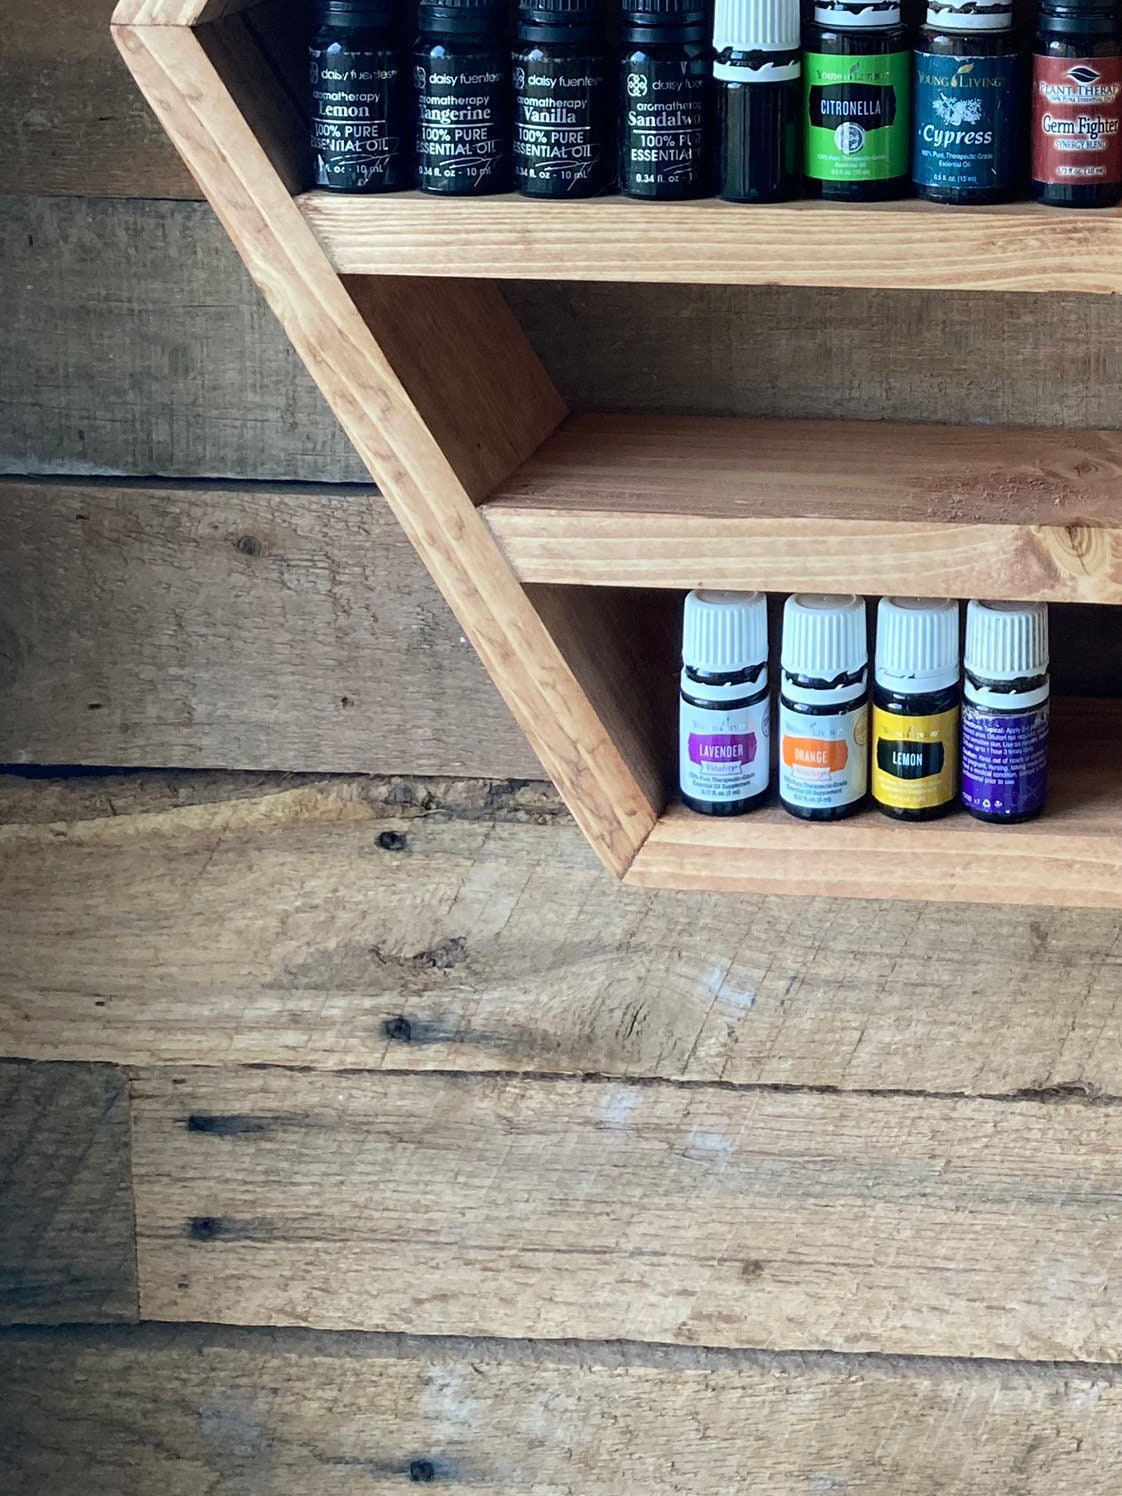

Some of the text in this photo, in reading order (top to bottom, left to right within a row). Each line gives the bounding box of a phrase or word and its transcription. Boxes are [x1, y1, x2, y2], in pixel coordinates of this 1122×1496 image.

[429, 73, 500, 86] daisy fuentes
[528, 75, 556, 88] daisy
[918, 71, 1001, 87] YOUNG LIVING
[1040, 82, 1072, 96] PLANT
[419, 95, 489, 106] aromatherapy
[517, 96, 587, 109] aromatherapy
[320, 102, 370, 117] Lemon
[420, 104, 491, 124] Tangerine
[523, 106, 576, 123] Vanilla
[820, 100, 881, 116] CITRONELLA
[628, 110, 701, 126] Sandalwo
[345, 126, 378, 137] PURE
[422, 128, 487, 141] 100% PURE
[1043, 115, 1118, 140] Germ Fighter
[519, 128, 584, 143] 100% PURE
[640, 135, 676, 147] 100%
[923, 124, 992, 148] Cypress
[366, 140, 389, 151] OIL
[416, 141, 496, 155] ESSENTIAL OIL
[513, 142, 592, 157] ESSENTIAL OIL
[1055, 141, 1084, 149] SYNERGY
[444, 169, 455, 177] oz
[467, 168, 477, 176] 10
[561, 171, 571, 179] 10
[635, 173, 655, 183] 0.34
[668, 175, 679, 183] oz
[700, 744, 743, 758] LAVENDER
[794, 748, 828, 763] ORANGE
[892, 751, 923, 766] LEMON
